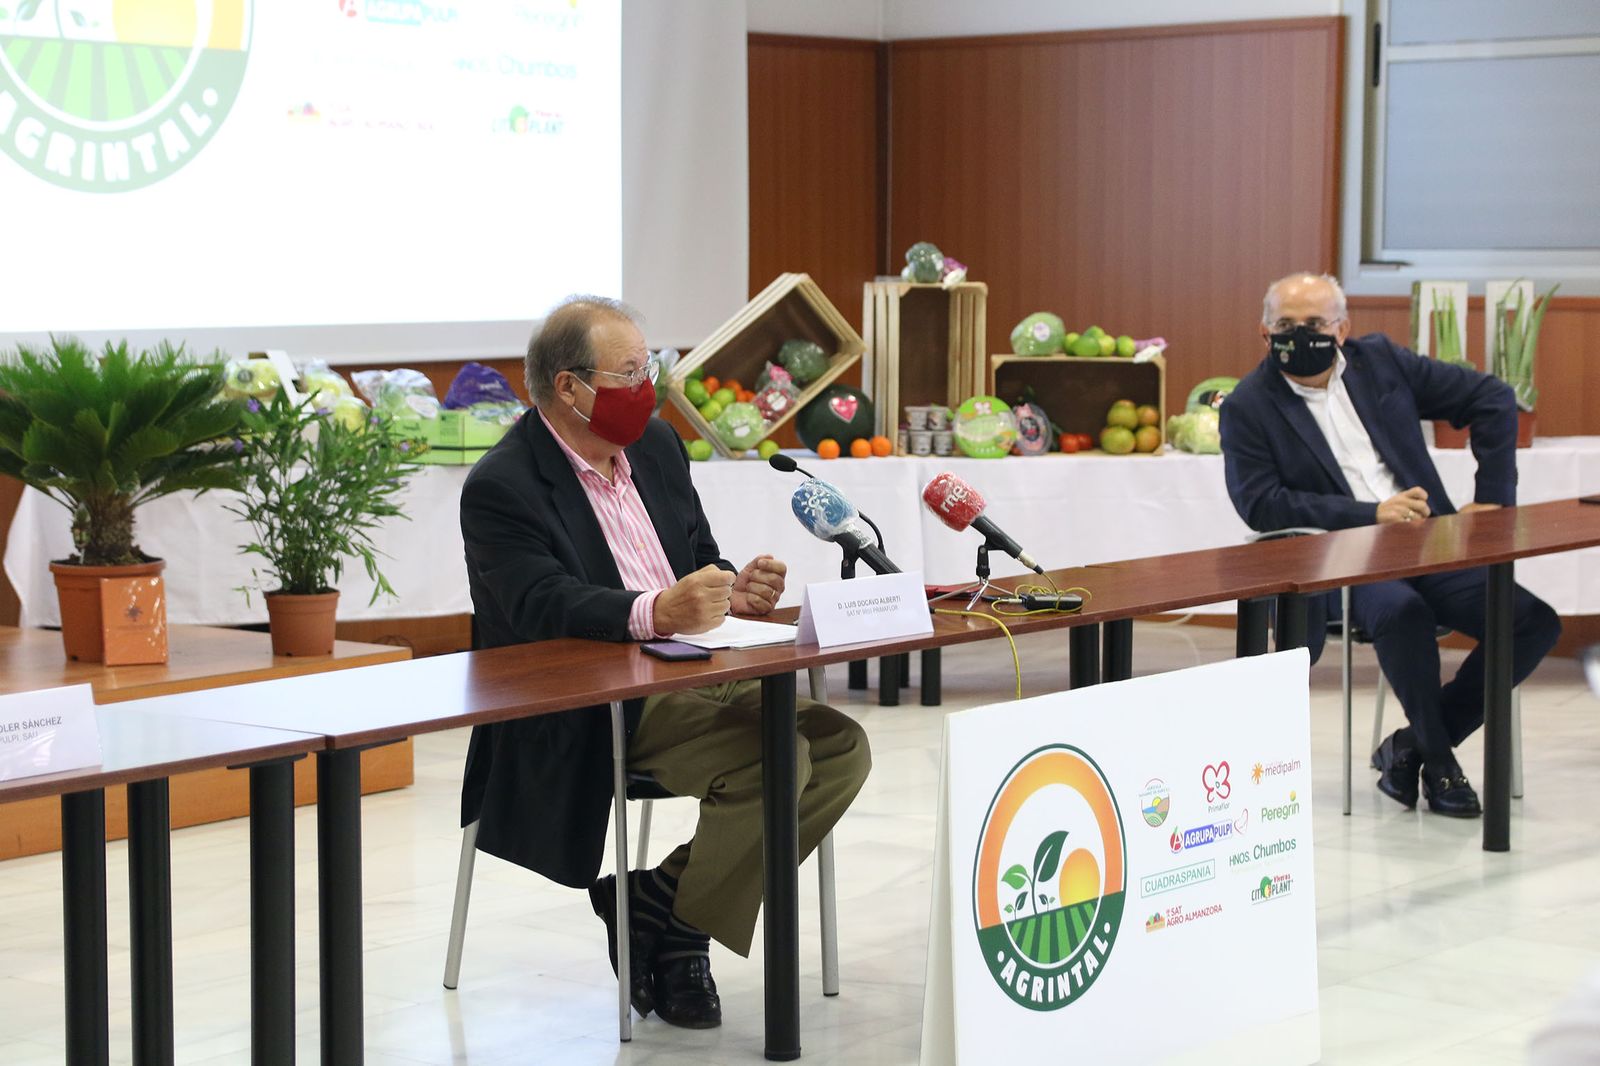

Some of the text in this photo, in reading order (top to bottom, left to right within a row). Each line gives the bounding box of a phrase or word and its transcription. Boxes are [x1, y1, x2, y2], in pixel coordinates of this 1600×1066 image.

[940, 485, 968, 513] rne
[844, 600, 857, 609] LUIS
[880, 595, 901, 604] ALBERTI
[1265, 759, 1301, 777] medipalm
[1208, 802, 1230, 814] Primaflor
[1261, 800, 1300, 823] Peregrin
[1253, 838, 1297, 860] Chumbos
[1144, 865, 1211, 893] CUADRASPANIA
[1166, 904, 1223, 928] AGRO ALMANZORA
[1171, 905, 1182, 917] SAT
[1000, 935, 1109, 1003] AGRINTAL
